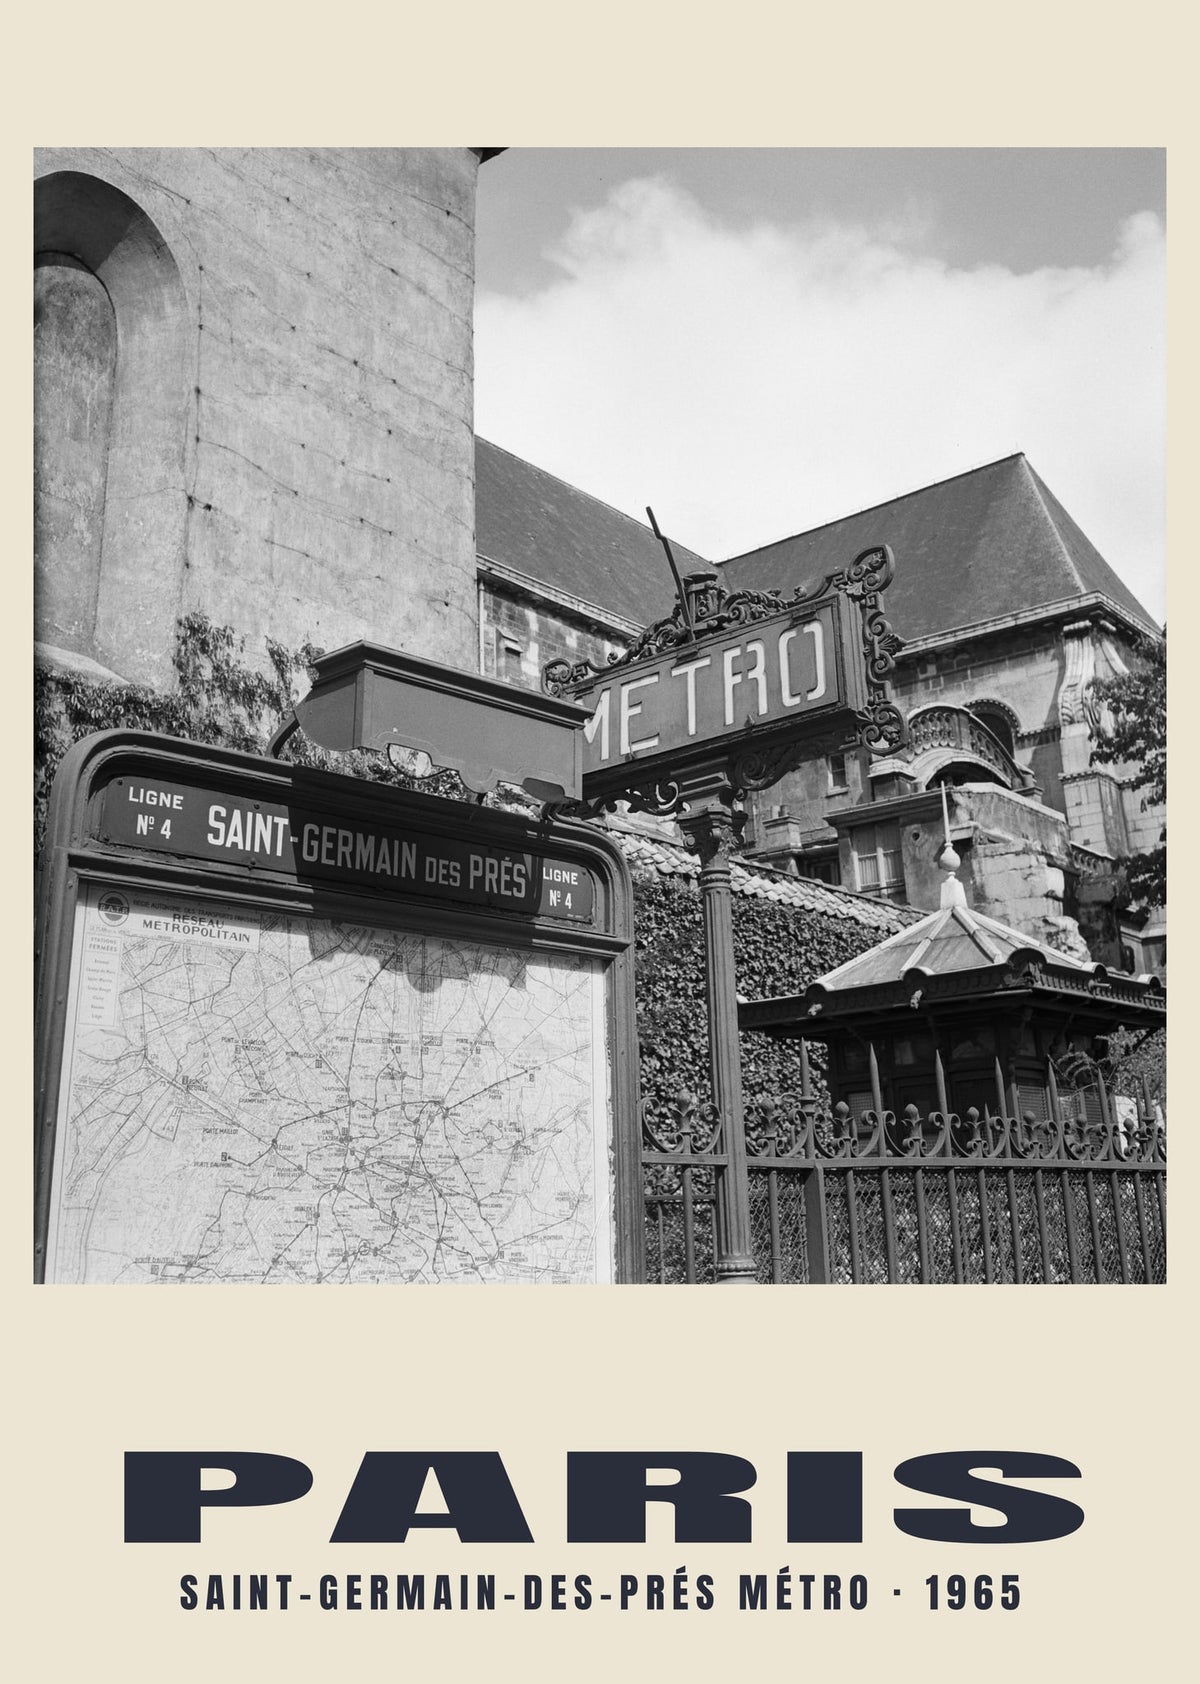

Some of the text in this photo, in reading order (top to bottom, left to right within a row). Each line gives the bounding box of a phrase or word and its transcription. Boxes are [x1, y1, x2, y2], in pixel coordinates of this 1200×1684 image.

[128, 786, 184, 810] LIGNE
[160, 819, 172, 840] 4
[207, 804, 526, 898] SAINT-GERMAIN DES PRÉS
[542, 866, 579, 886] LIGNE
[564, 892, 573, 910] 4
